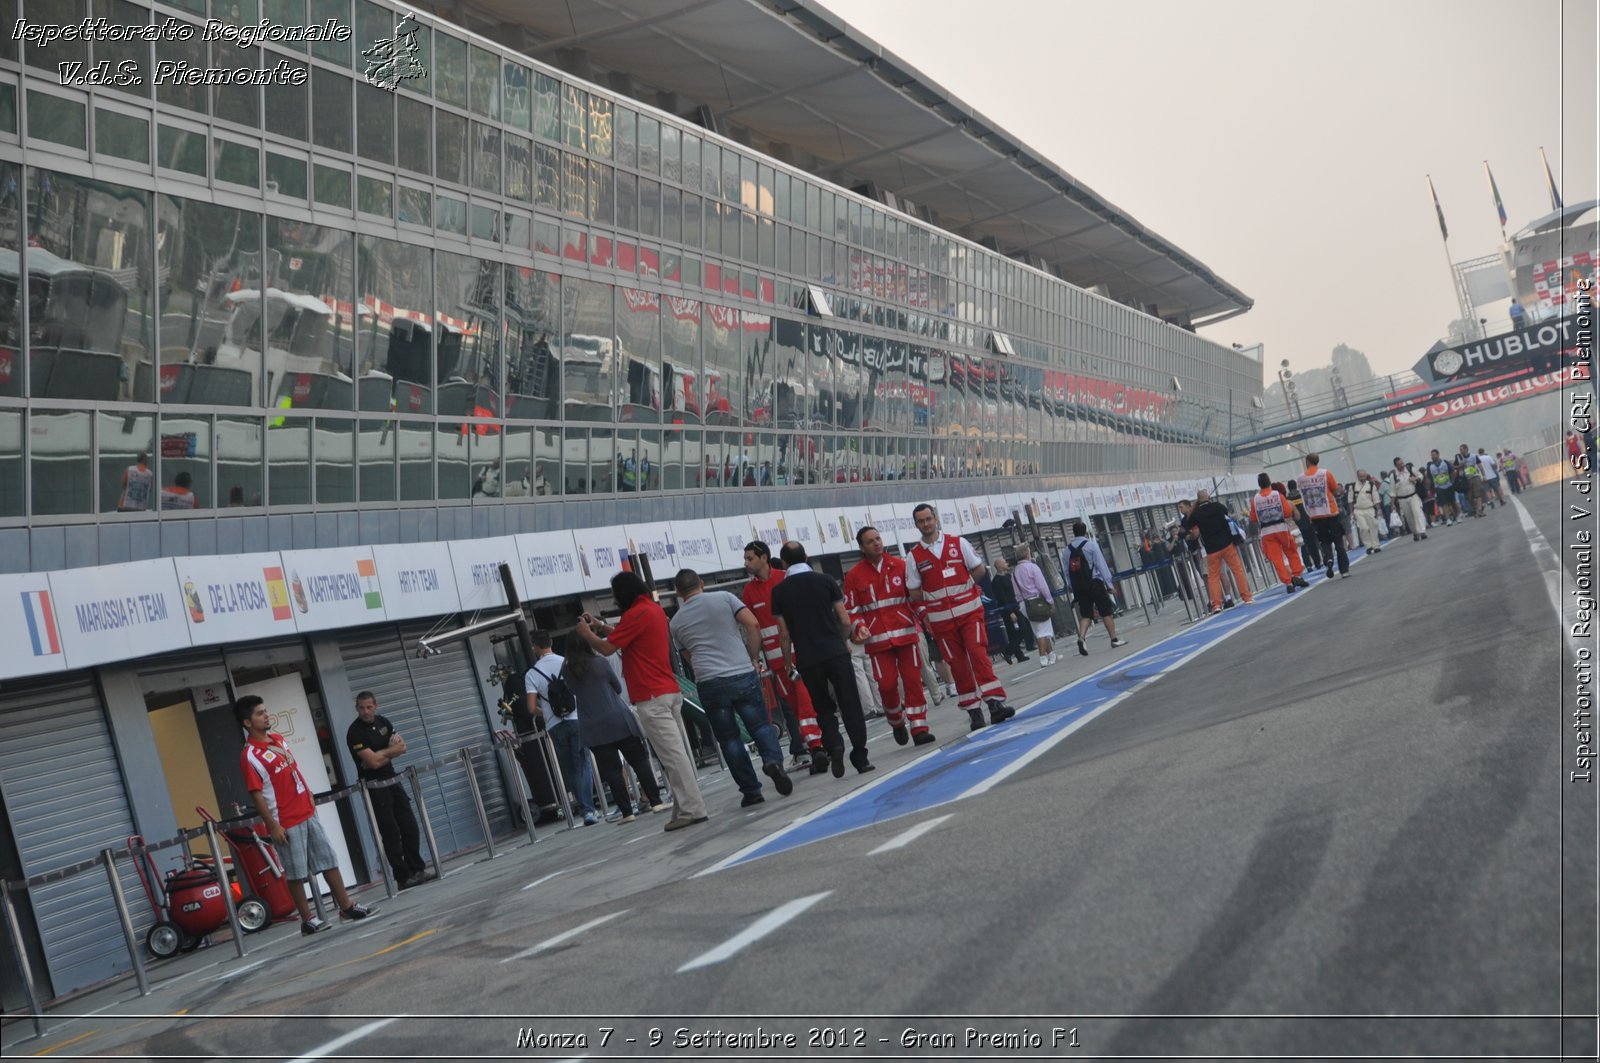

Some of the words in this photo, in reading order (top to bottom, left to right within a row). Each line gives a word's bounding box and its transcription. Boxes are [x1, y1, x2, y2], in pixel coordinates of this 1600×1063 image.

[1464, 320, 1571, 367] HUBLOT
[1431, 366, 1576, 417] Santande
[558, 553, 574, 573] TEAM
[594, 547, 614, 568] PETROV
[398, 570, 412, 592] HRT
[410, 570, 420, 592] F1
[418, 568, 440, 592] TEAM
[471, 564, 483, 585] HRT
[208, 584, 226, 613] DE
[222, 583, 239, 612] LA
[236, 581, 268, 611] ROSA
[307, 572, 363, 603] KARTHIKEYAN
[75, 598, 130, 634] MARUSSIA
[128, 597, 142, 626] F1
[139, 593, 168, 622] TEAM
[204, 886, 220, 897] CEA
[183, 902, 201, 912] CEA
